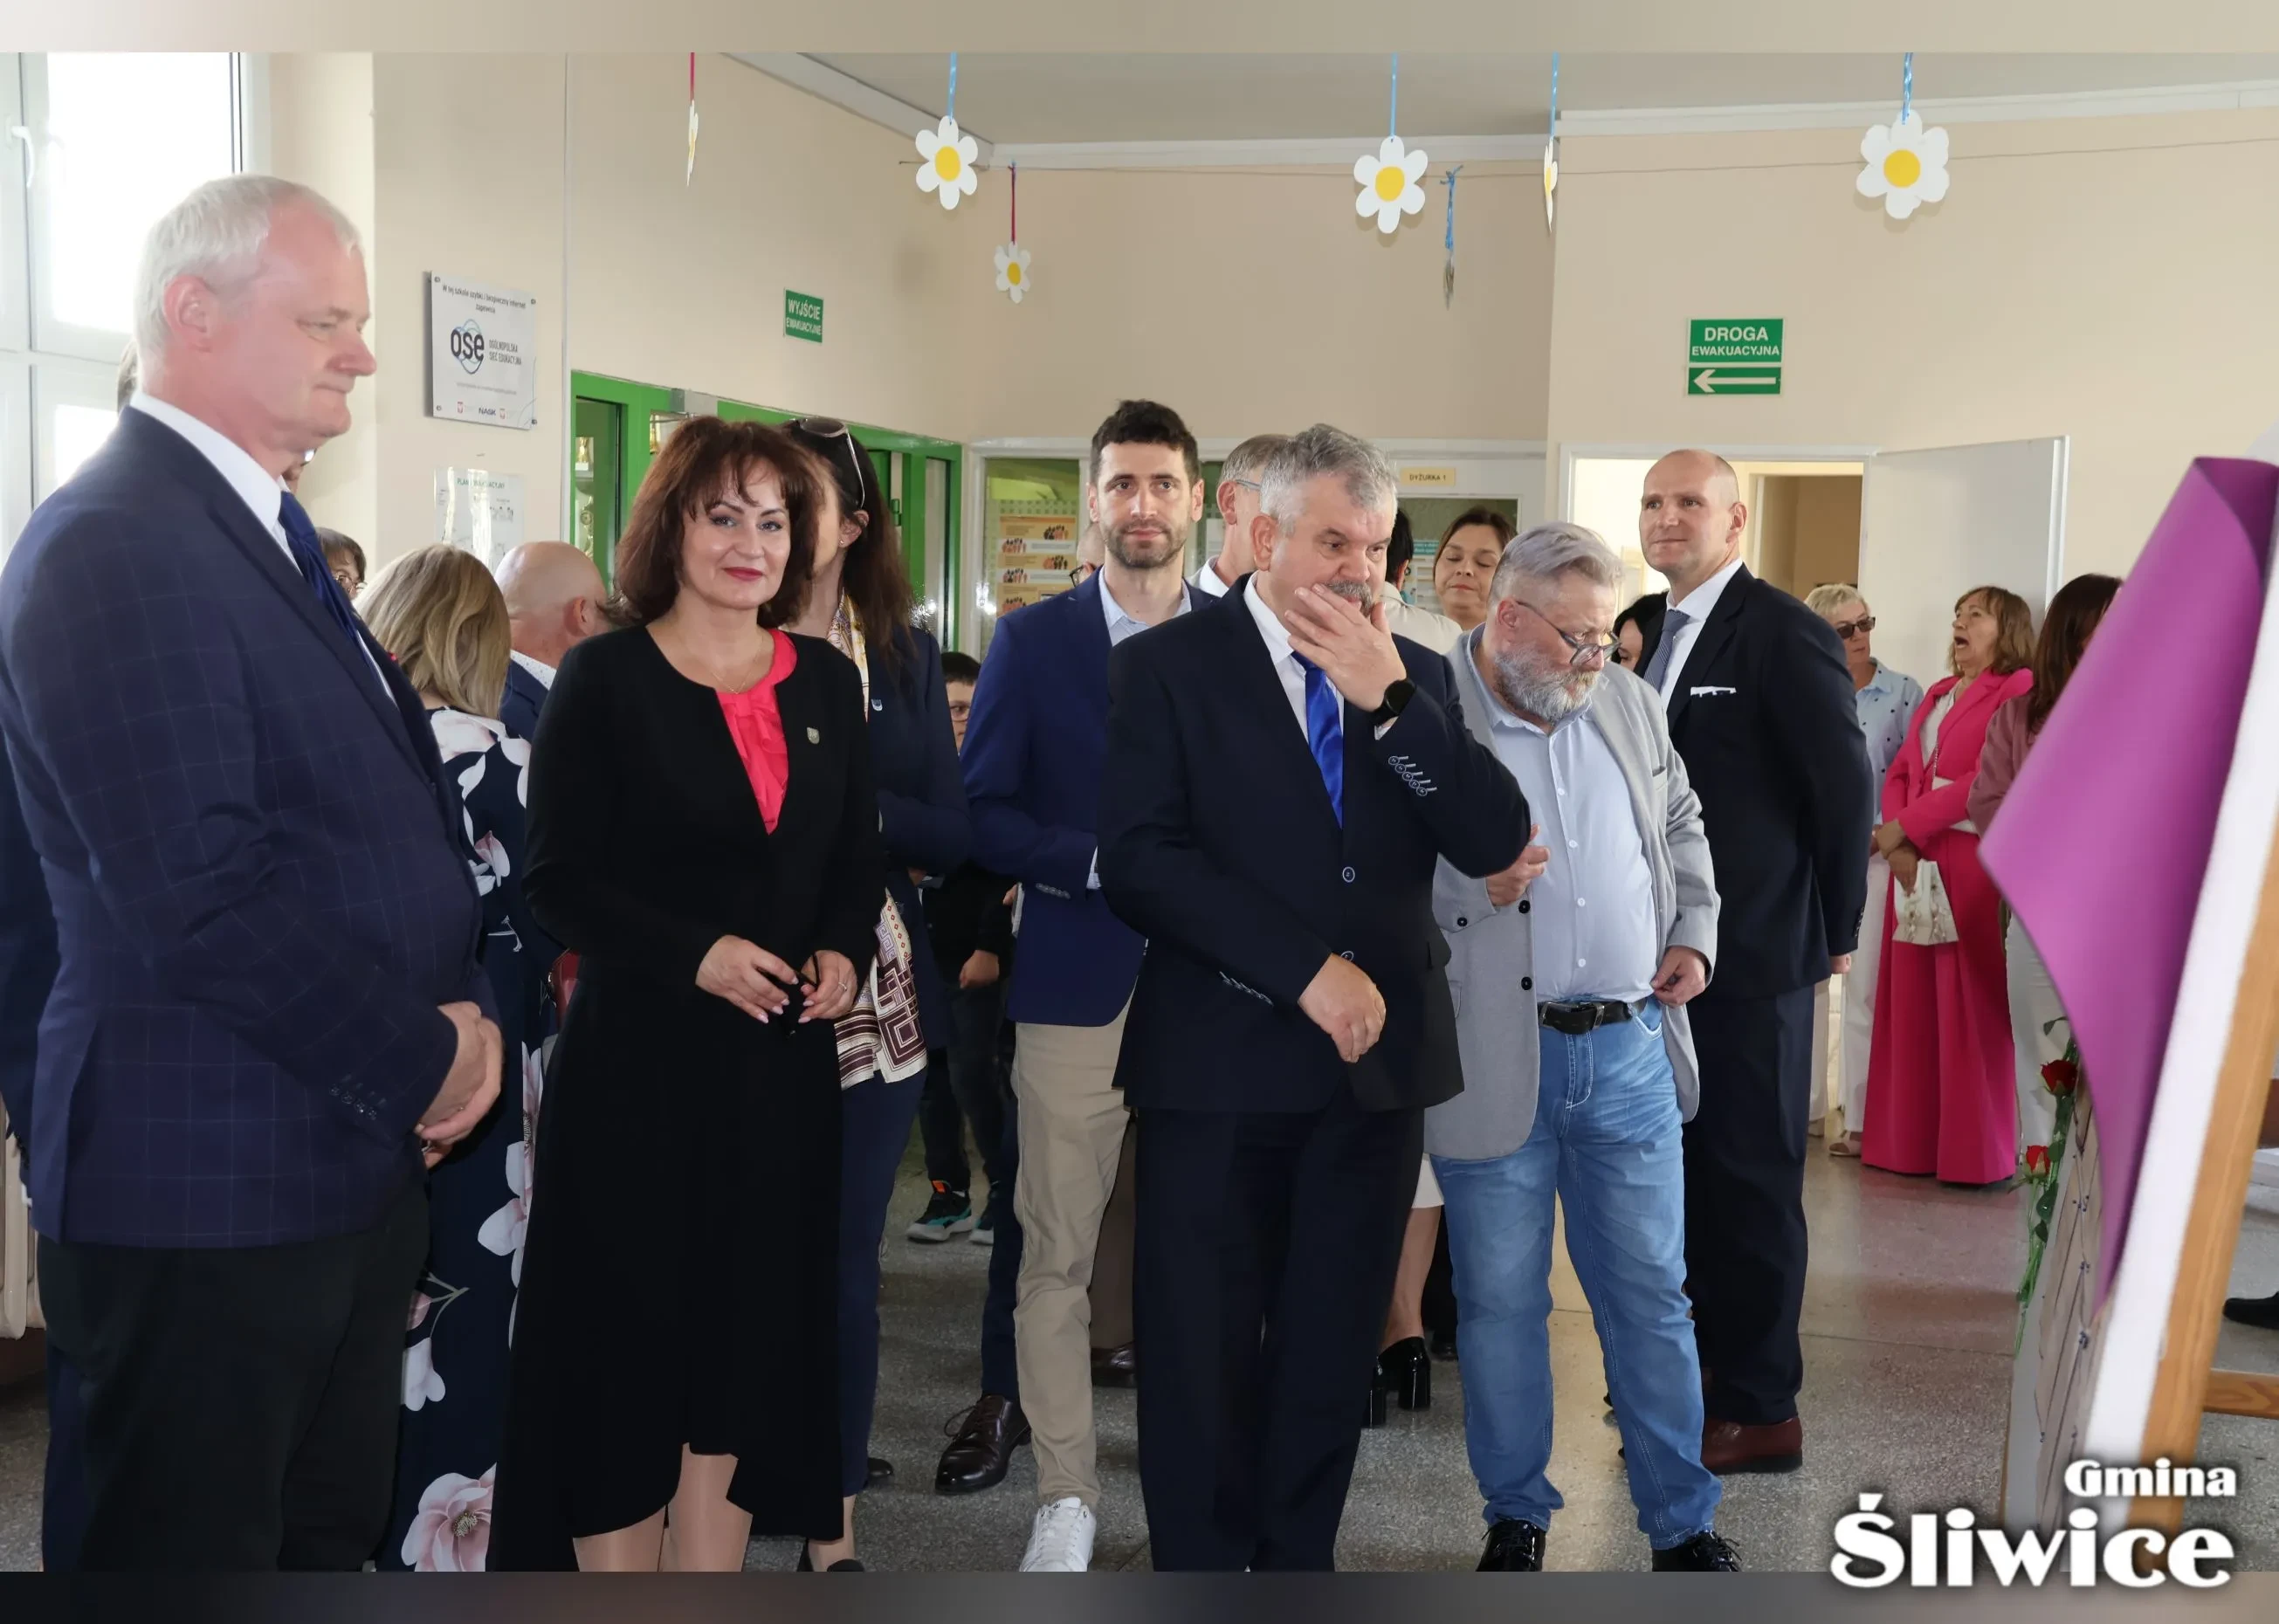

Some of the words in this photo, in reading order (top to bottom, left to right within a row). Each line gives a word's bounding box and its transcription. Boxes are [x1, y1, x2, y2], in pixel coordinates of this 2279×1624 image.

[788, 298, 821, 320] WYJŚCIE
[786, 317, 822, 336] EWAKUACYJNE
[1704, 327, 1769, 341] DROGA
[451, 328, 485, 361] ose
[489, 339, 518, 353] OGÓLNOPOLSKA
[1691, 346, 1780, 356] EWAKUACYJNA
[499, 353, 522, 366] EDUKACYJNA
[479, 407, 497, 416] NASK
[1409, 472, 1441, 481] DYŻURKA
